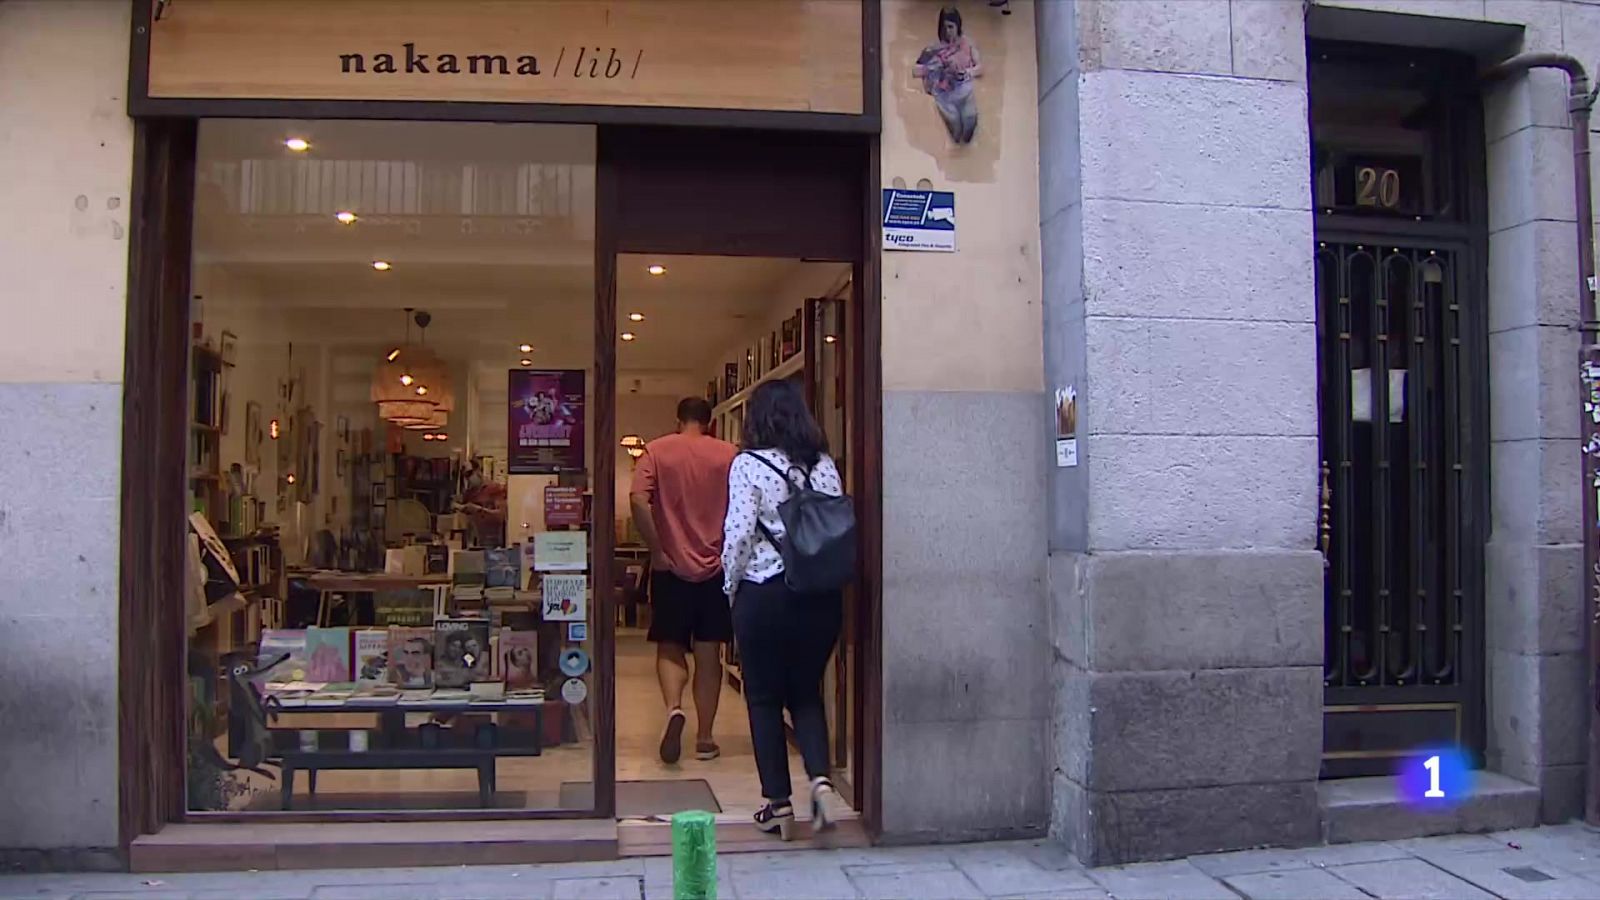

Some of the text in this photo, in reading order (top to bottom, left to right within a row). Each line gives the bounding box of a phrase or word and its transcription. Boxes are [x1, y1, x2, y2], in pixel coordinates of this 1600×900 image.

[340, 43, 540, 75] nakama
[1358, 167, 1400, 207] 20
[885, 233, 914, 244] tyco
[437, 622, 469, 631] LOVING
